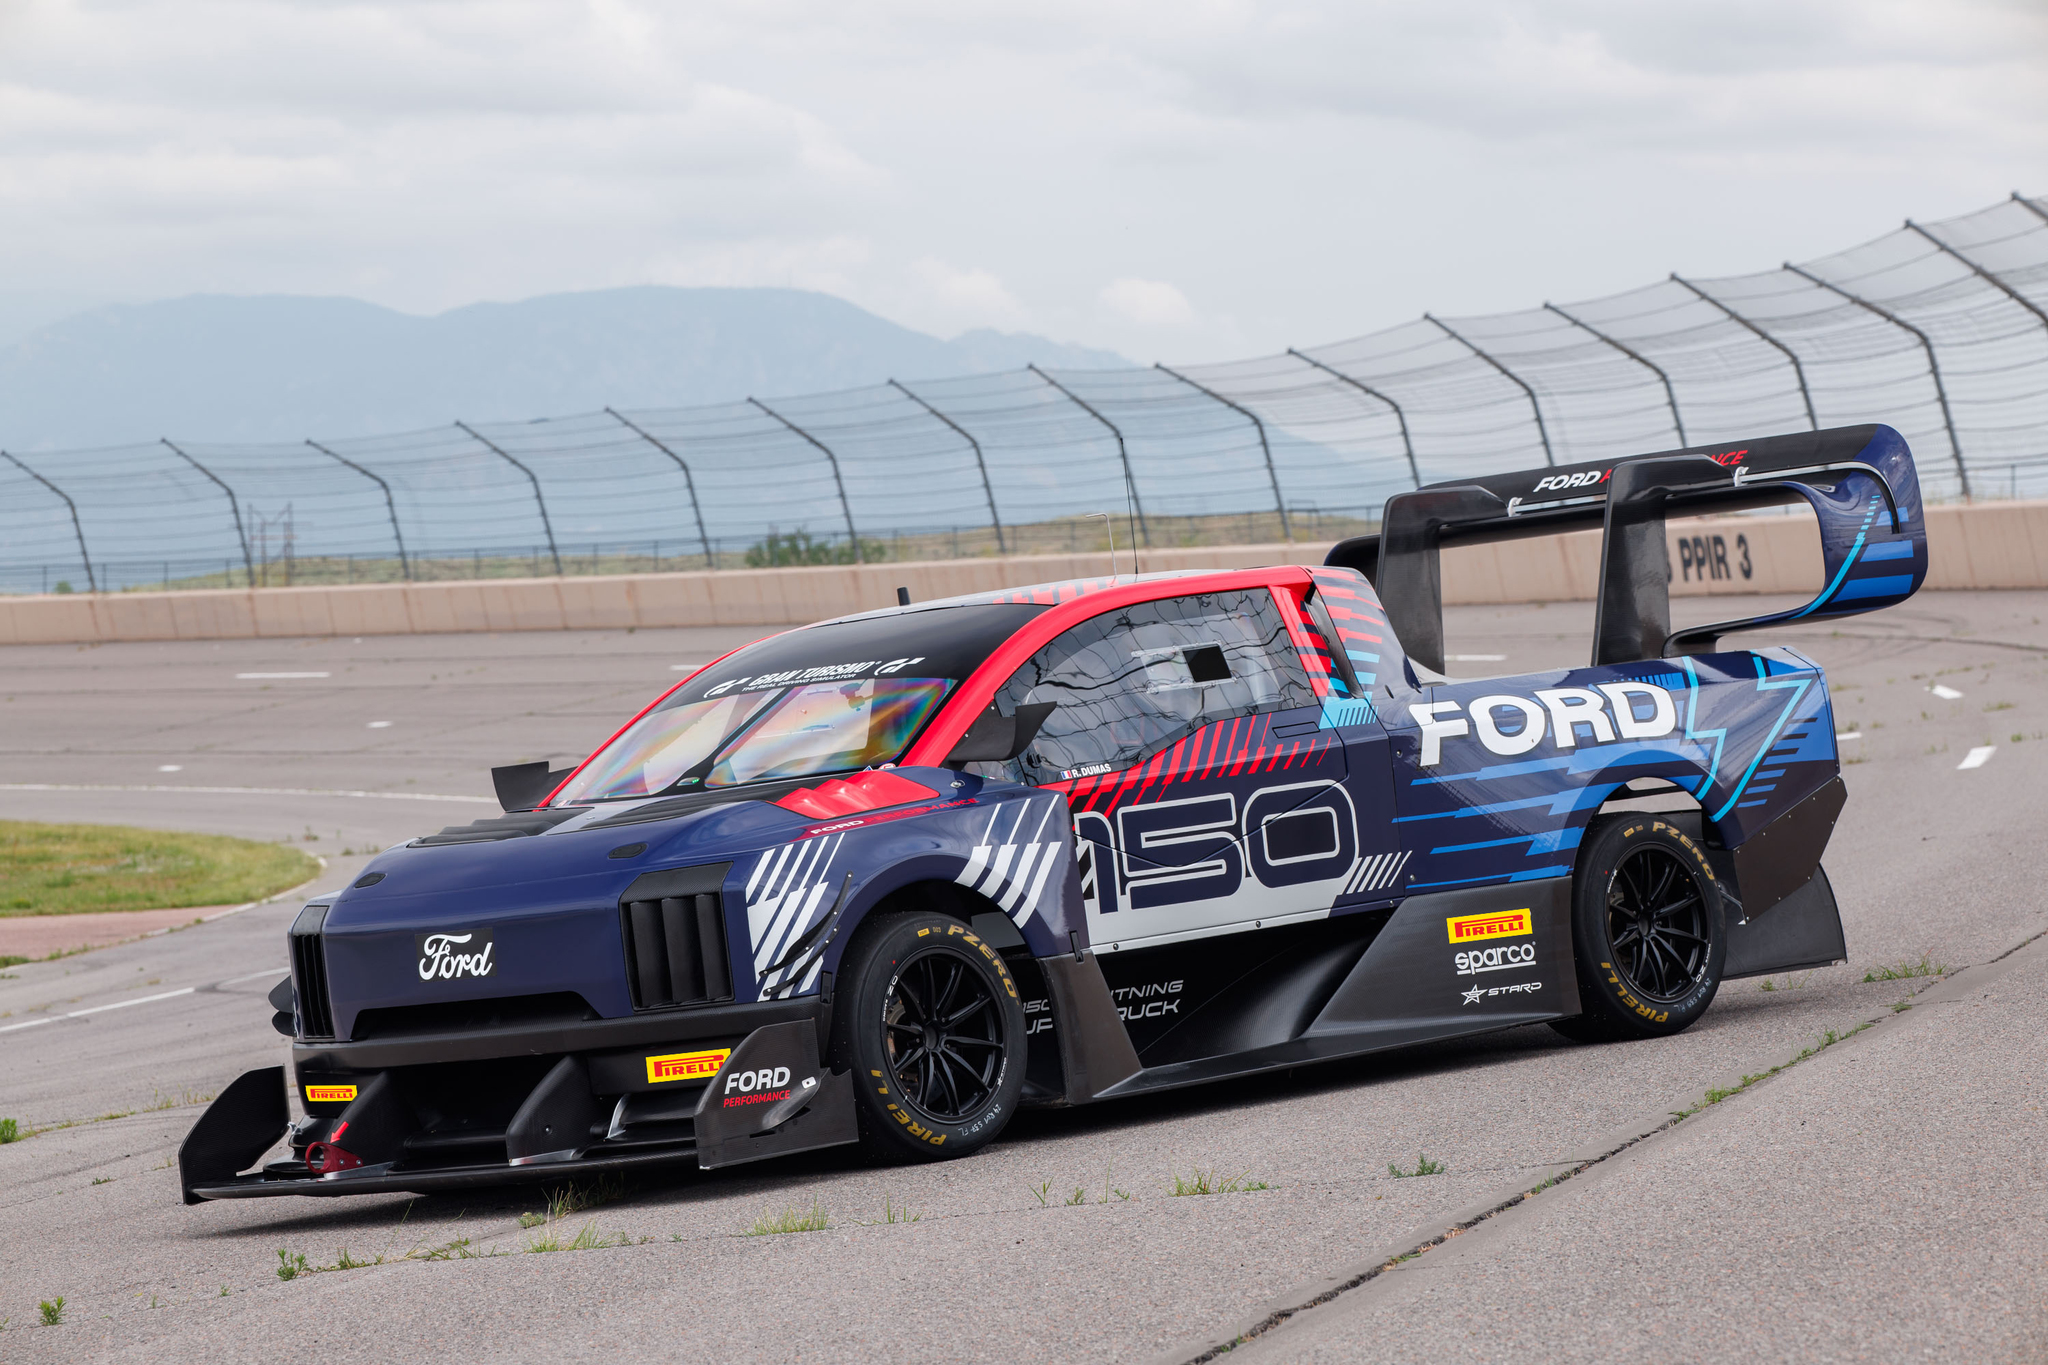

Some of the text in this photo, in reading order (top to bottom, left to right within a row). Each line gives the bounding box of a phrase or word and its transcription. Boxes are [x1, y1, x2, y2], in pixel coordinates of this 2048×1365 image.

[1533, 470, 1602, 493] FORD
[1678, 534, 1732, 582] PPIR
[1736, 533, 1752, 580] 3
[741, 683, 757, 692] THE
[757, 682, 777, 690] REAL
[809, 673, 857, 683] SIMULATOR
[748, 669, 803, 686] GRAN
[796, 661, 876, 680] TURISMO
[1409, 681, 1676, 767] FORD
[1081, 763, 1112, 776] DUMAS
[811, 797, 980, 835] FORD PERFORMANCE
[1453, 914, 1524, 938] PIRELLI
[418, 933, 493, 980] Ford
[1454, 943, 1536, 975] sparco
[1487, 982, 1542, 997] STARD
[1601, 962, 1669, 1023] PIRELLI
[653, 1054, 725, 1077] PIRELLI
[724, 1066, 791, 1095] FORD
[310, 1088, 353, 1098] PIRELLI
[723, 1090, 791, 1108] PERFORMANCE
